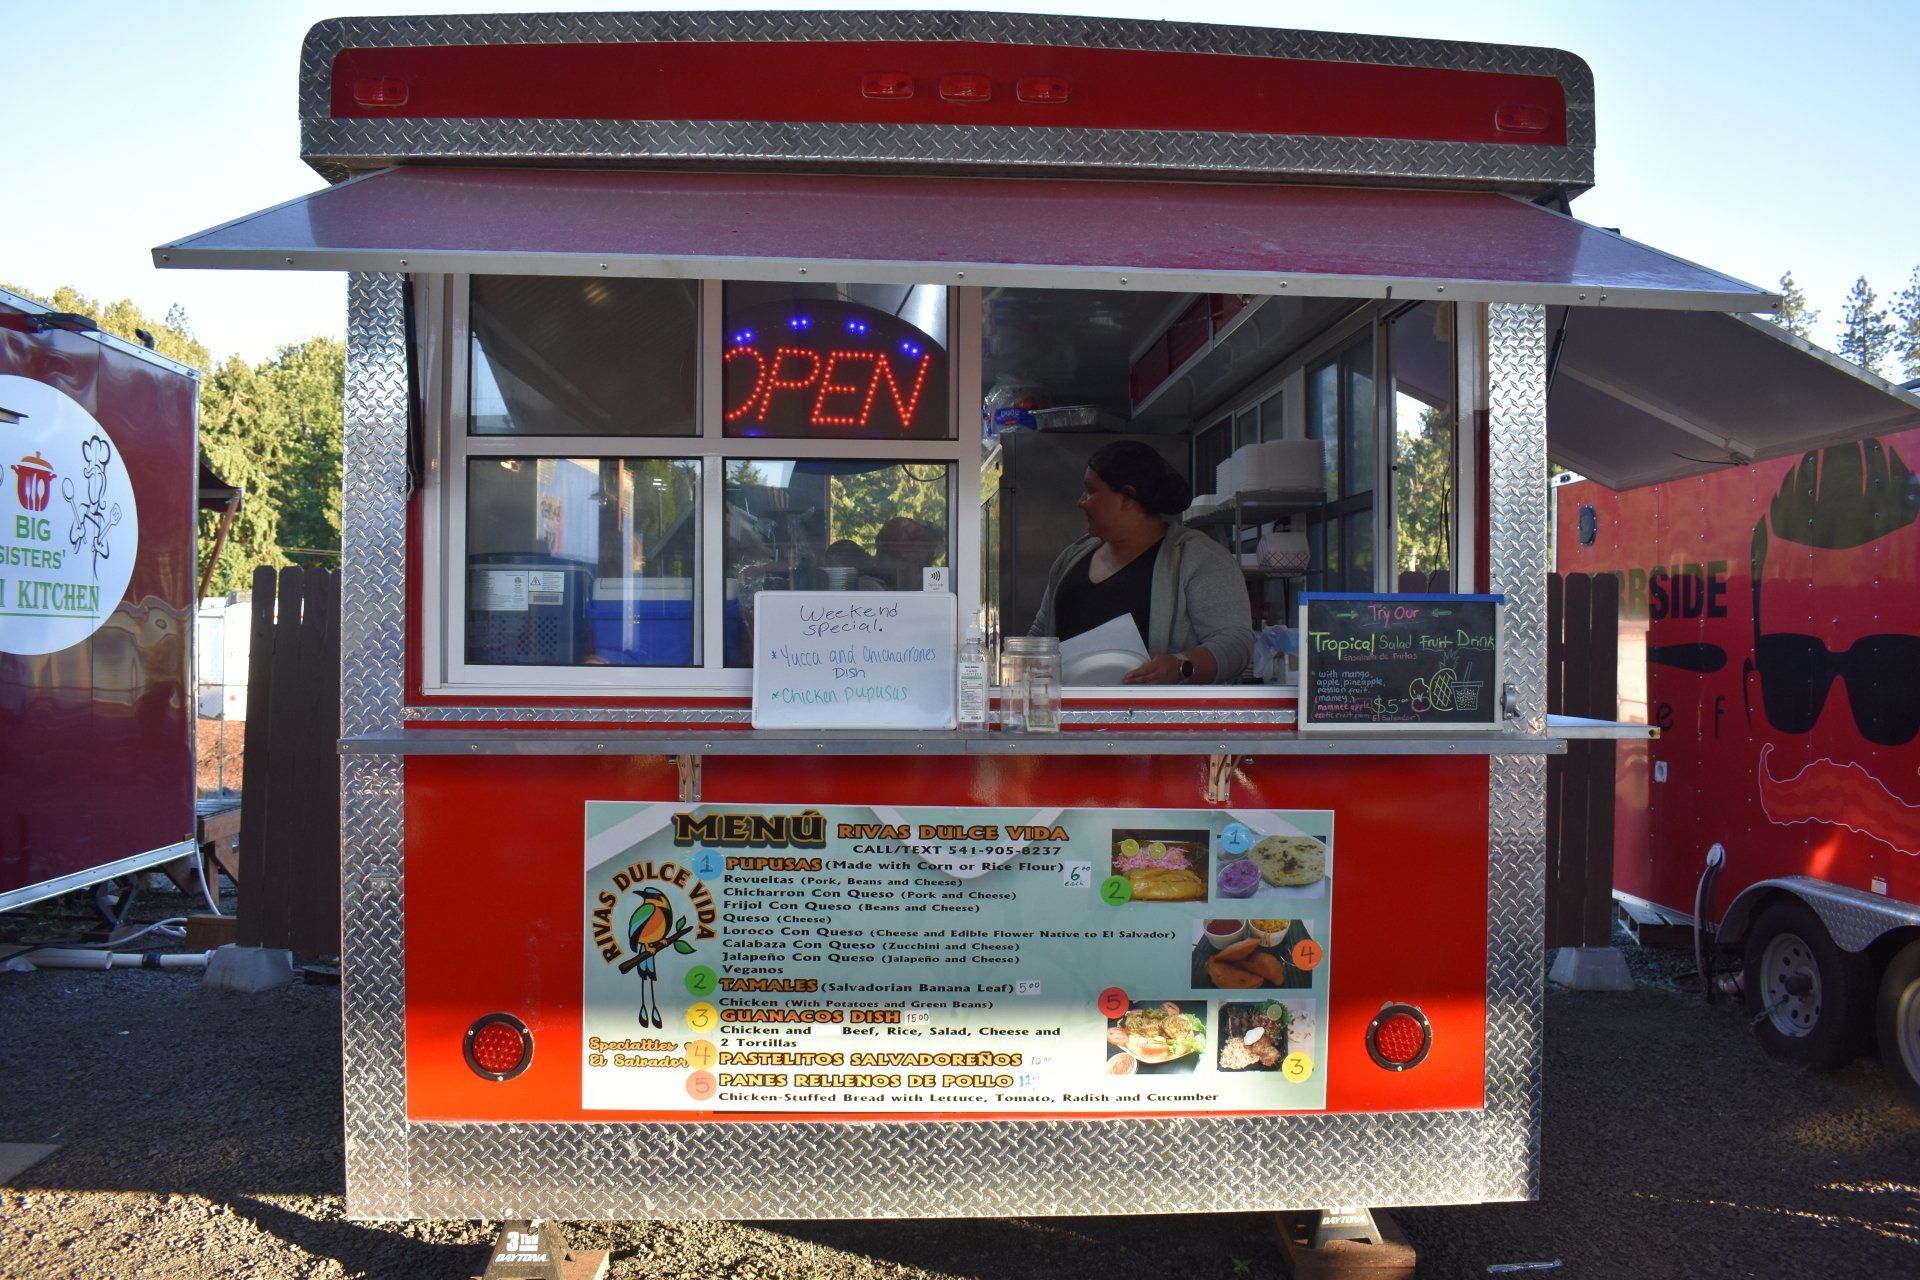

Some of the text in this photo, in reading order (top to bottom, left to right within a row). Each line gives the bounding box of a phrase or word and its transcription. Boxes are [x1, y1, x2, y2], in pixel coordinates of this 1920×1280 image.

[725, 346, 931, 426] OPEN
[15, 514, 51, 542] BIG
[17, 579, 100, 612] KITCHEN
[1610, 560, 1728, 620] BSIDE
[800, 602, 899, 622] Weekend
[1368, 605, 1420, 628] Try Our
[1308, 628, 1496, 661] Tropical Salad Fruit Drink
[779, 644, 937, 667] Yucca and Chicharrones
[1318, 670, 1339, 679] with
[671, 809, 827, 849] MENÚ
[836, 822, 1071, 842] RIVAS DULCE VIDA
[1229, 828, 1241, 846] 1
[852, 844, 1061, 856] CALL/TEXT 541-905-8237
[699, 854, 714, 874] 1
[725, 856, 824, 872] PUPUSAS
[824, 860, 873, 871] (Made
[877, 860, 911, 870] with
[916, 861, 953, 871] Corn
[981, 861, 1013, 872] Rice
[1018, 862, 1064, 873] Flour)
[610, 859, 693, 894] DULCE
[723, 874, 963, 888] Revueltas (Pork, Beans and Cheese)
[722, 886, 1017, 901] Chicharron Con Queso (Pork and Cheese)
[1108, 880, 1125, 900] 2
[687, 879, 718, 941] VIDA
[723, 899, 980, 913] Frijol Con Queso (Beans and Cheese)
[722, 912, 832, 925] Queso (Cheese)
[590, 889, 625, 967] RIVAS
[722, 925, 774, 936] Loroco
[780, 926, 810, 936] Con
[815, 926, 864, 938] Queso
[869, 929, 919, 938] (Cheese
[923, 929, 945, 938] and
[950, 929, 988, 938] Edible
[993, 930, 1035, 938] Flower
[1039, 929, 1080, 938] Native
[1102, 930, 1114, 938] El
[1118, 930, 1176, 940] Salvador)
[722, 938, 1020, 952] Calabaza Con Queso (Zucchini and Cheese)
[722, 951, 1020, 964] Jalapeño Con Queso (Jalapeño and Cheese)
[1300, 944, 1315, 965] 4
[721, 964, 784, 976] Veganos
[693, 972, 708, 990] 2
[717, 977, 1014, 994] TAMALES (Salvadorian Banana Leaf)
[718, 996, 994, 1010] Chicken (With Potatoes and Green Beans)
[1105, 994, 1122, 1011] 5
[691, 1008, 709, 1028] 3
[719, 1008, 901, 1024] GUANACOS DISH
[719, 1024, 1061, 1037] Chicken and Beef, Rice, Salad, Cheese and
[720, 1037, 729, 1047] 2
[735, 1038, 797, 1048] Tortillas
[588, 1053, 690, 1069] El Salvador
[694, 1045, 711, 1066] 4
[718, 1050, 1023, 1067] PASTELITOS SALVADOREÑOS
[1290, 1058, 1306, 1076] 3
[694, 1076, 711, 1095] 5
[718, 1072, 1015, 1089] PANES RELLENOS DE POLLO
[718, 1092, 1220, 1103] Chicken-Stuffed Bread with Lettuce, Tomato, Radish and Cucumber
[506, 1231, 520, 1252] 3
[494, 1252, 549, 1263] DAYTONA
